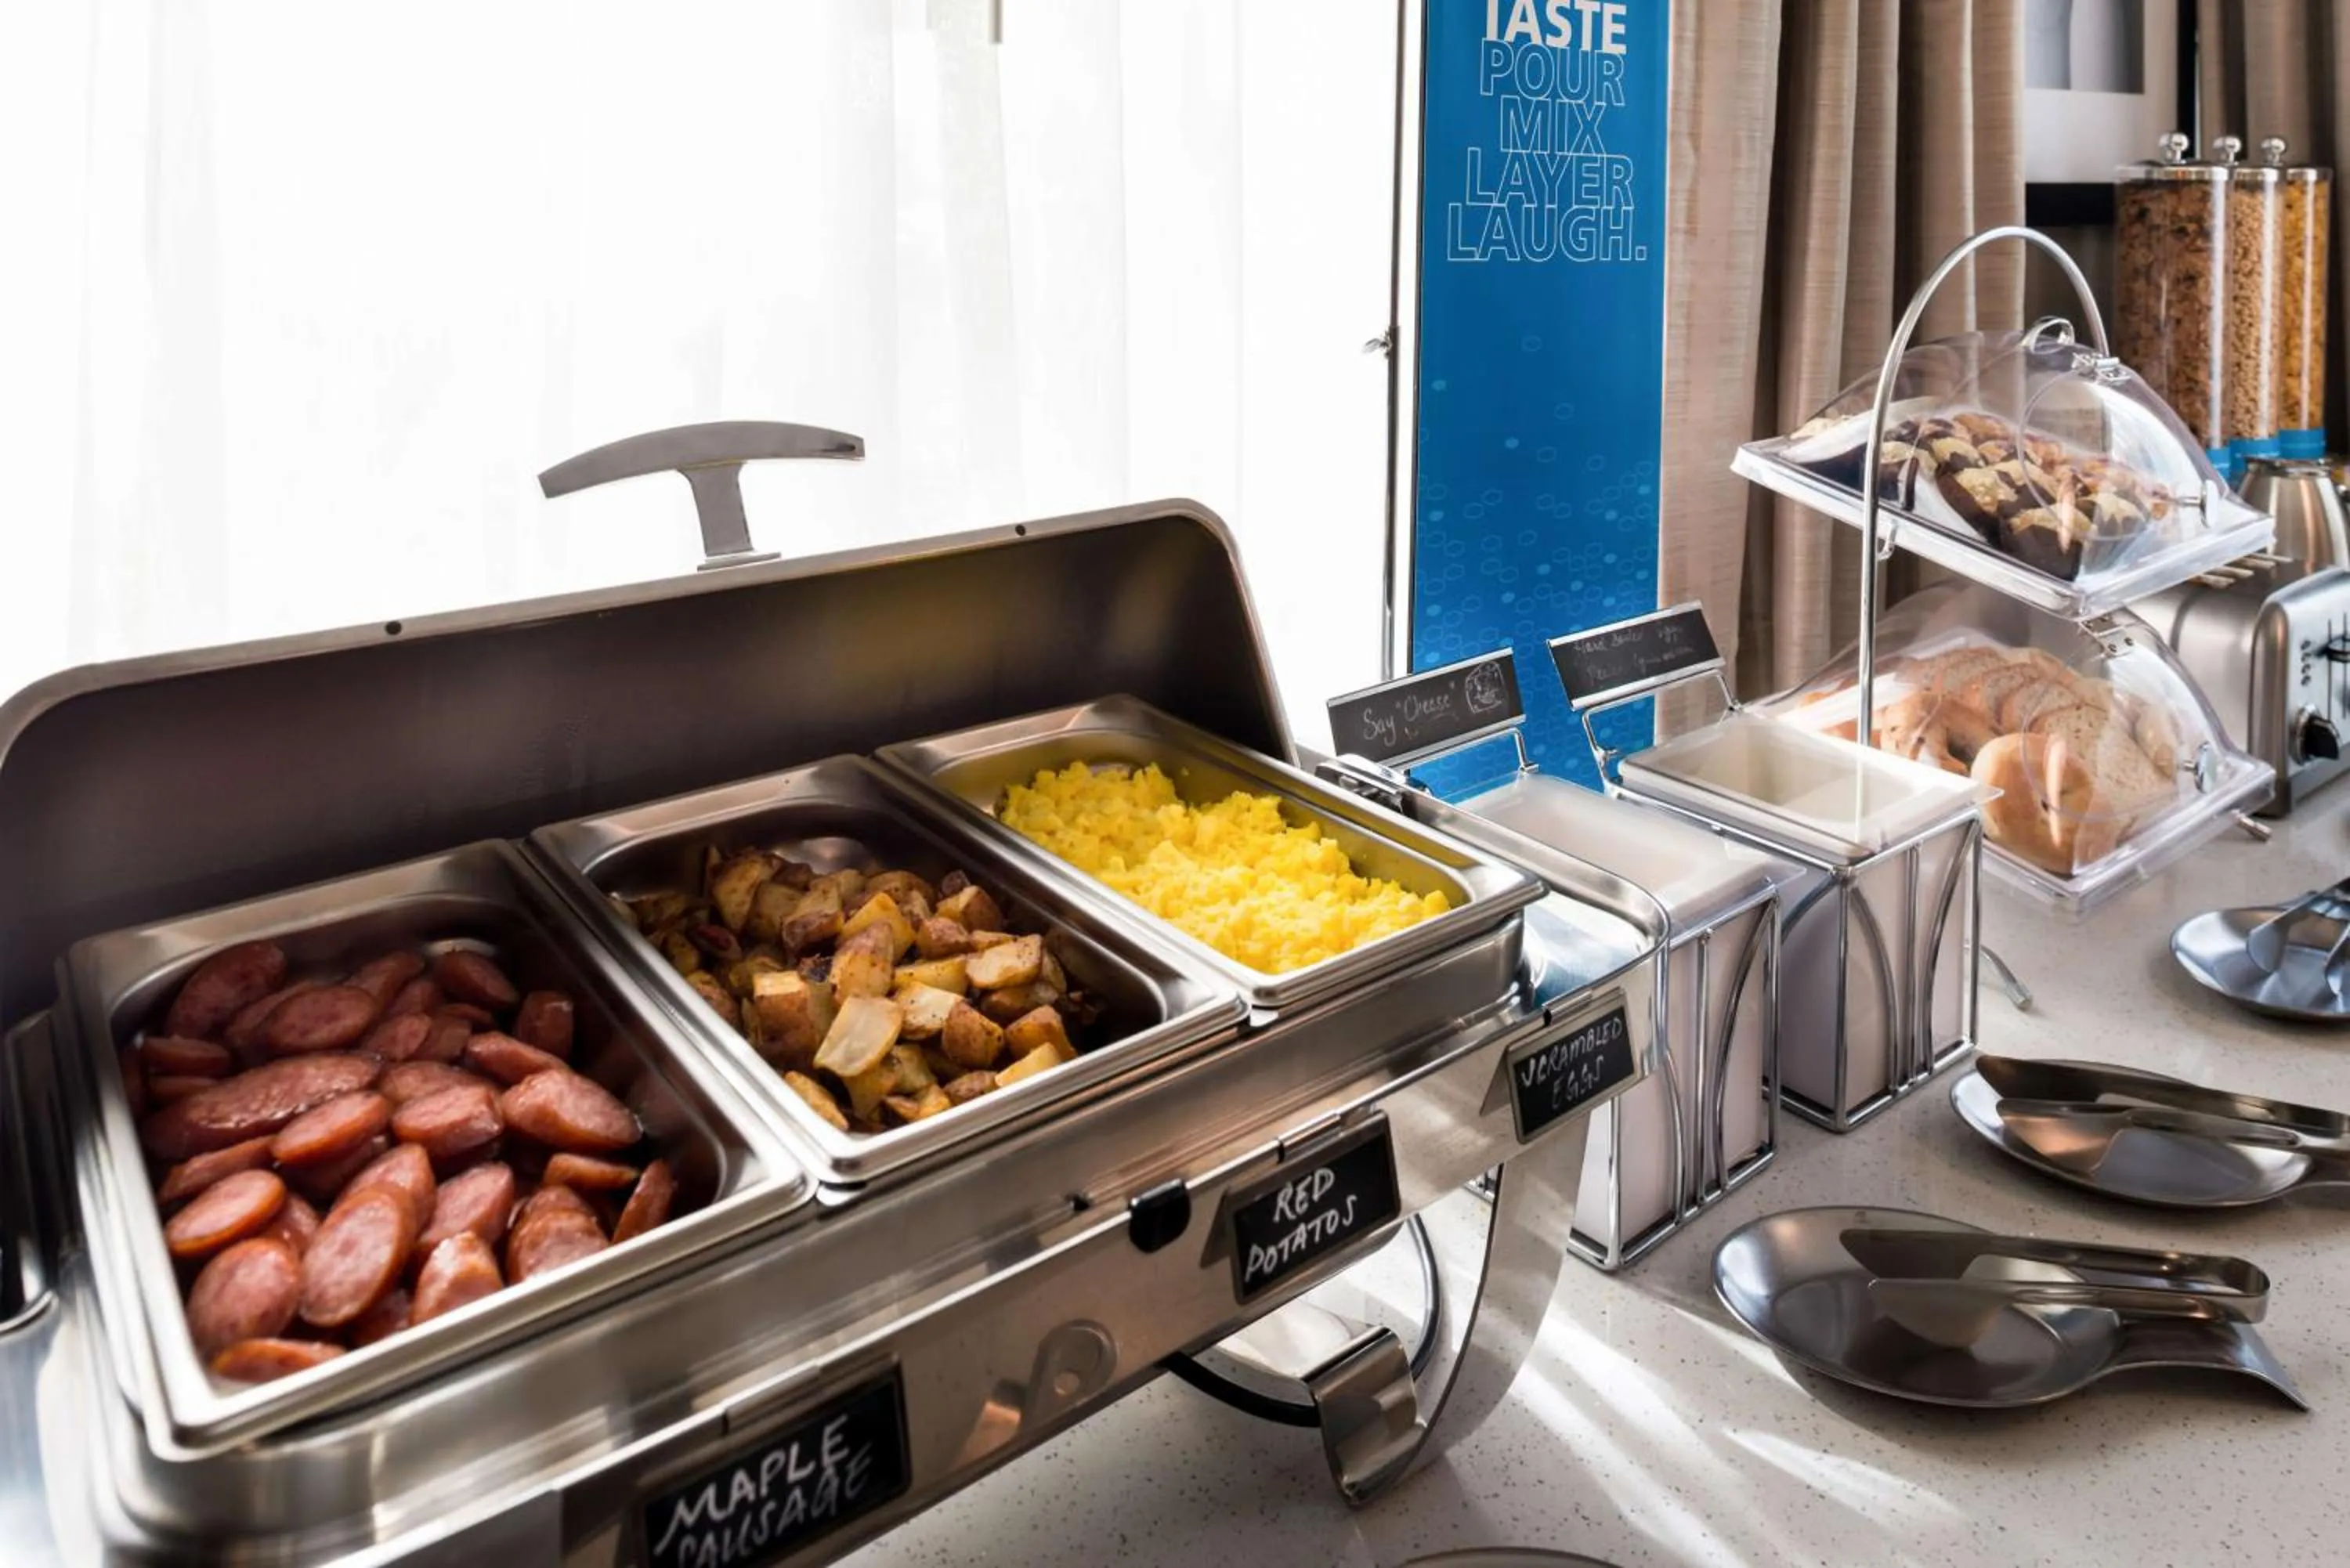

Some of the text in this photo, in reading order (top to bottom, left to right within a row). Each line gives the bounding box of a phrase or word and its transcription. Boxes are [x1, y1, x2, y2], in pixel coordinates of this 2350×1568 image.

[1480, 38, 1625, 107] POUR
[1500, 95, 1605, 156] MIX
[1466, 146, 1634, 209] LAYER
[1447, 203, 1647, 262] LAUGH.
[1363, 708, 1397, 746] Say
[1273, 1167, 1335, 1223] RED
[1245, 1194, 1358, 1282] POTATOS
[653, 1413, 850, 1555] MAPLE
